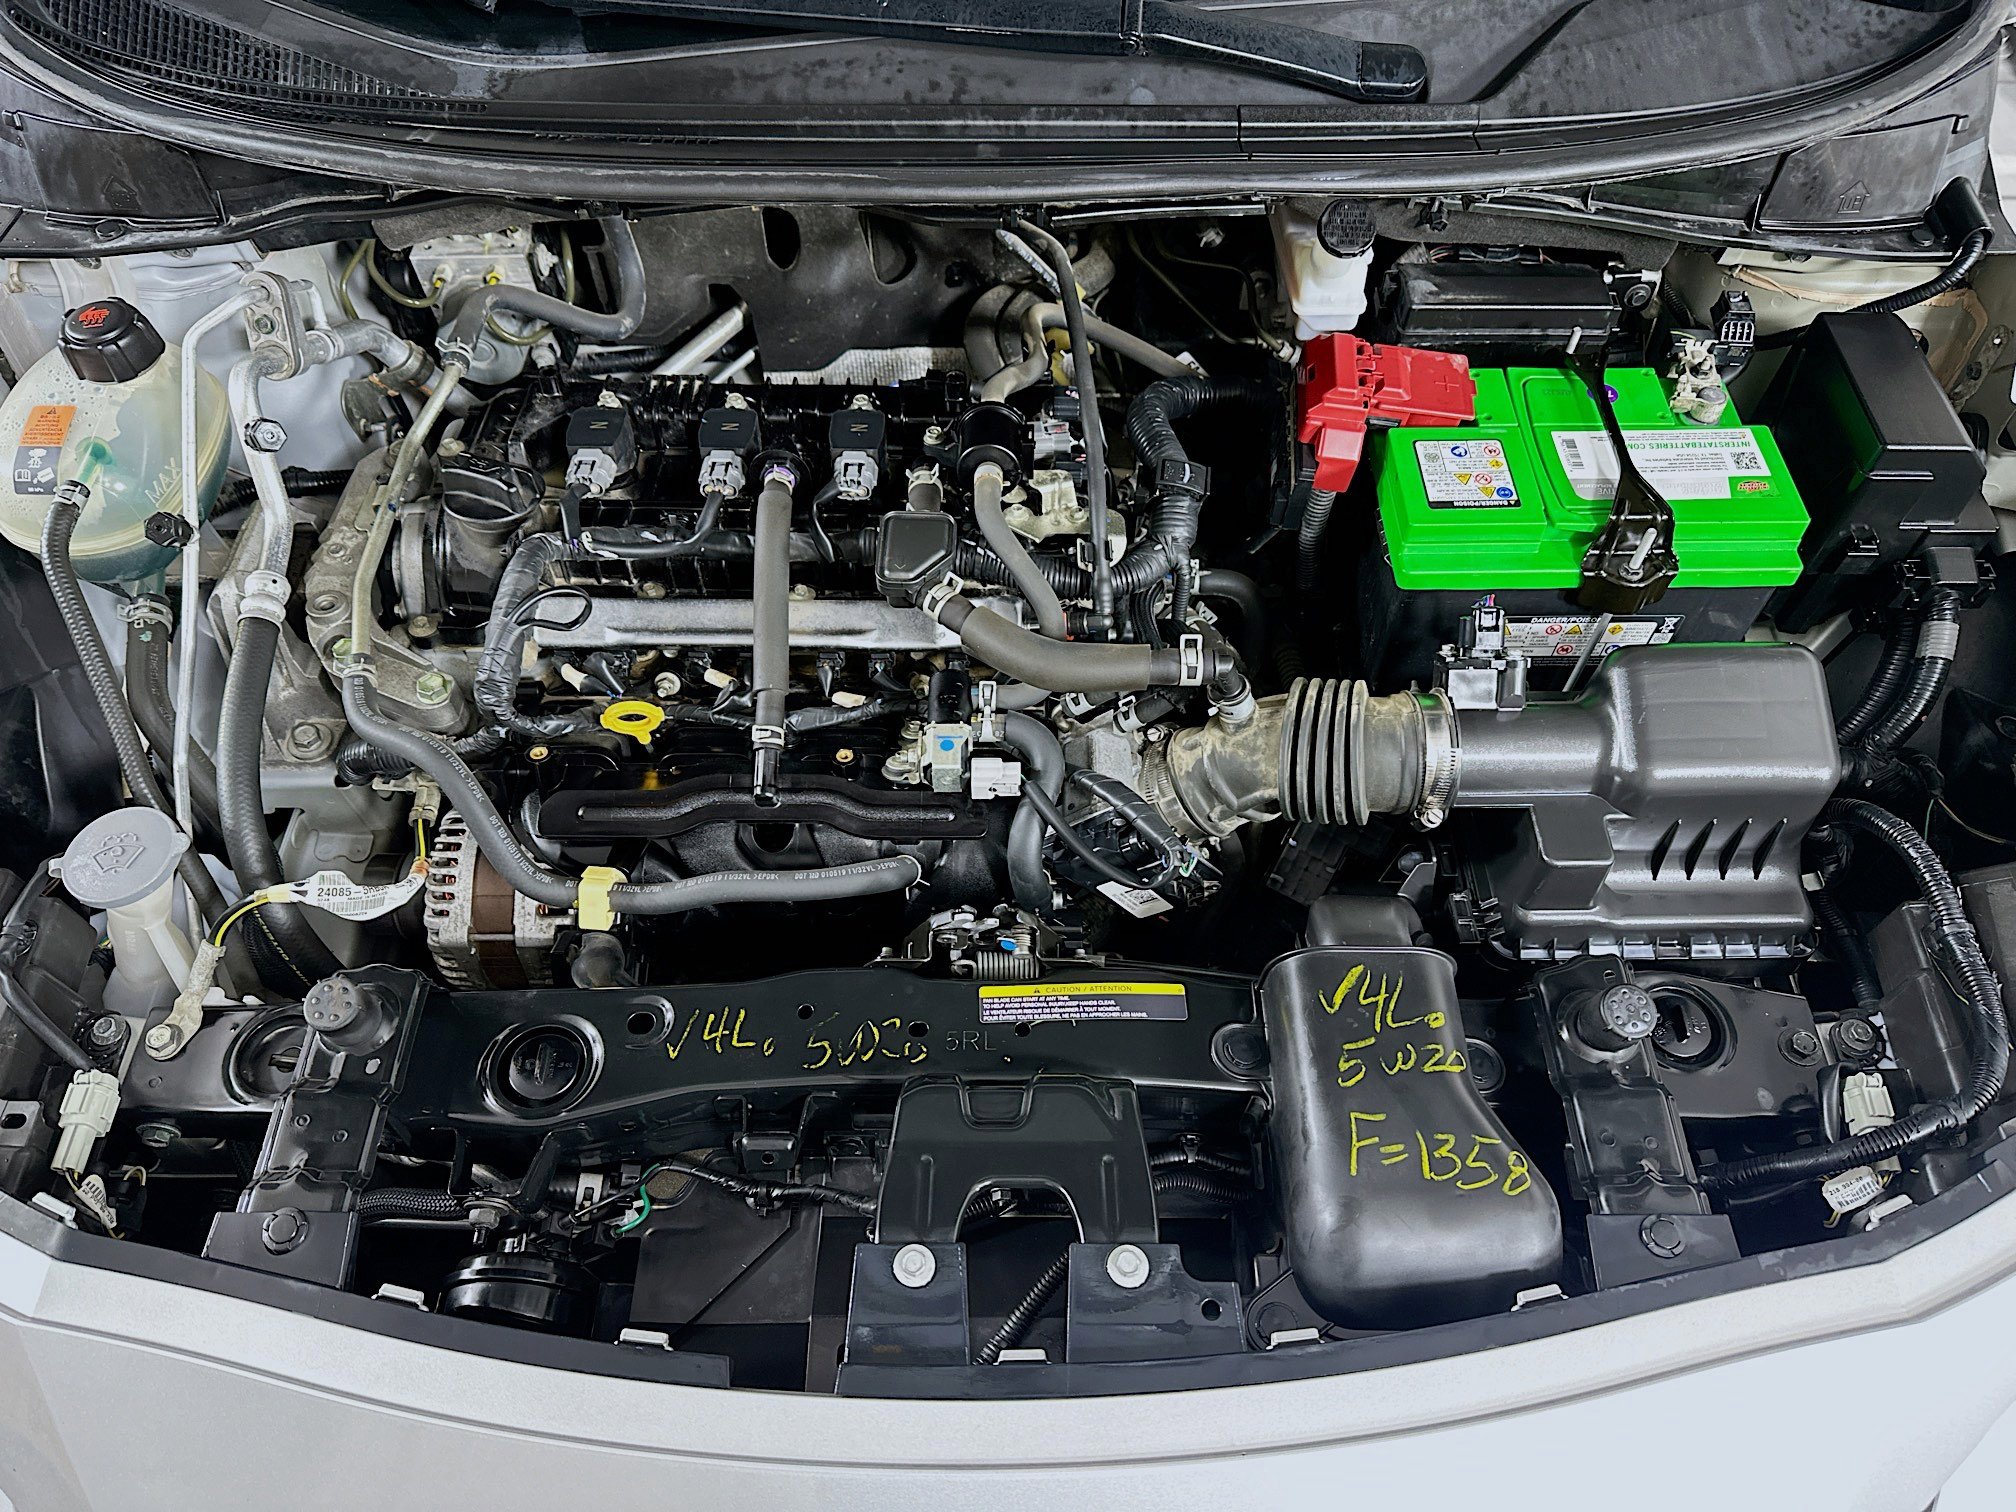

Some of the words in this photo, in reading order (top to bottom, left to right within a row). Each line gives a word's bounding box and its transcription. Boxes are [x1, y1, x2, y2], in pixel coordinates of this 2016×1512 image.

[1626, 441, 1751, 450] INTERSTATEBATTERIES.COM
[144, 456, 182, 506] MAX
[820, 868, 846, 878] 010519
[1046, 986, 1080, 994] CAUTION
